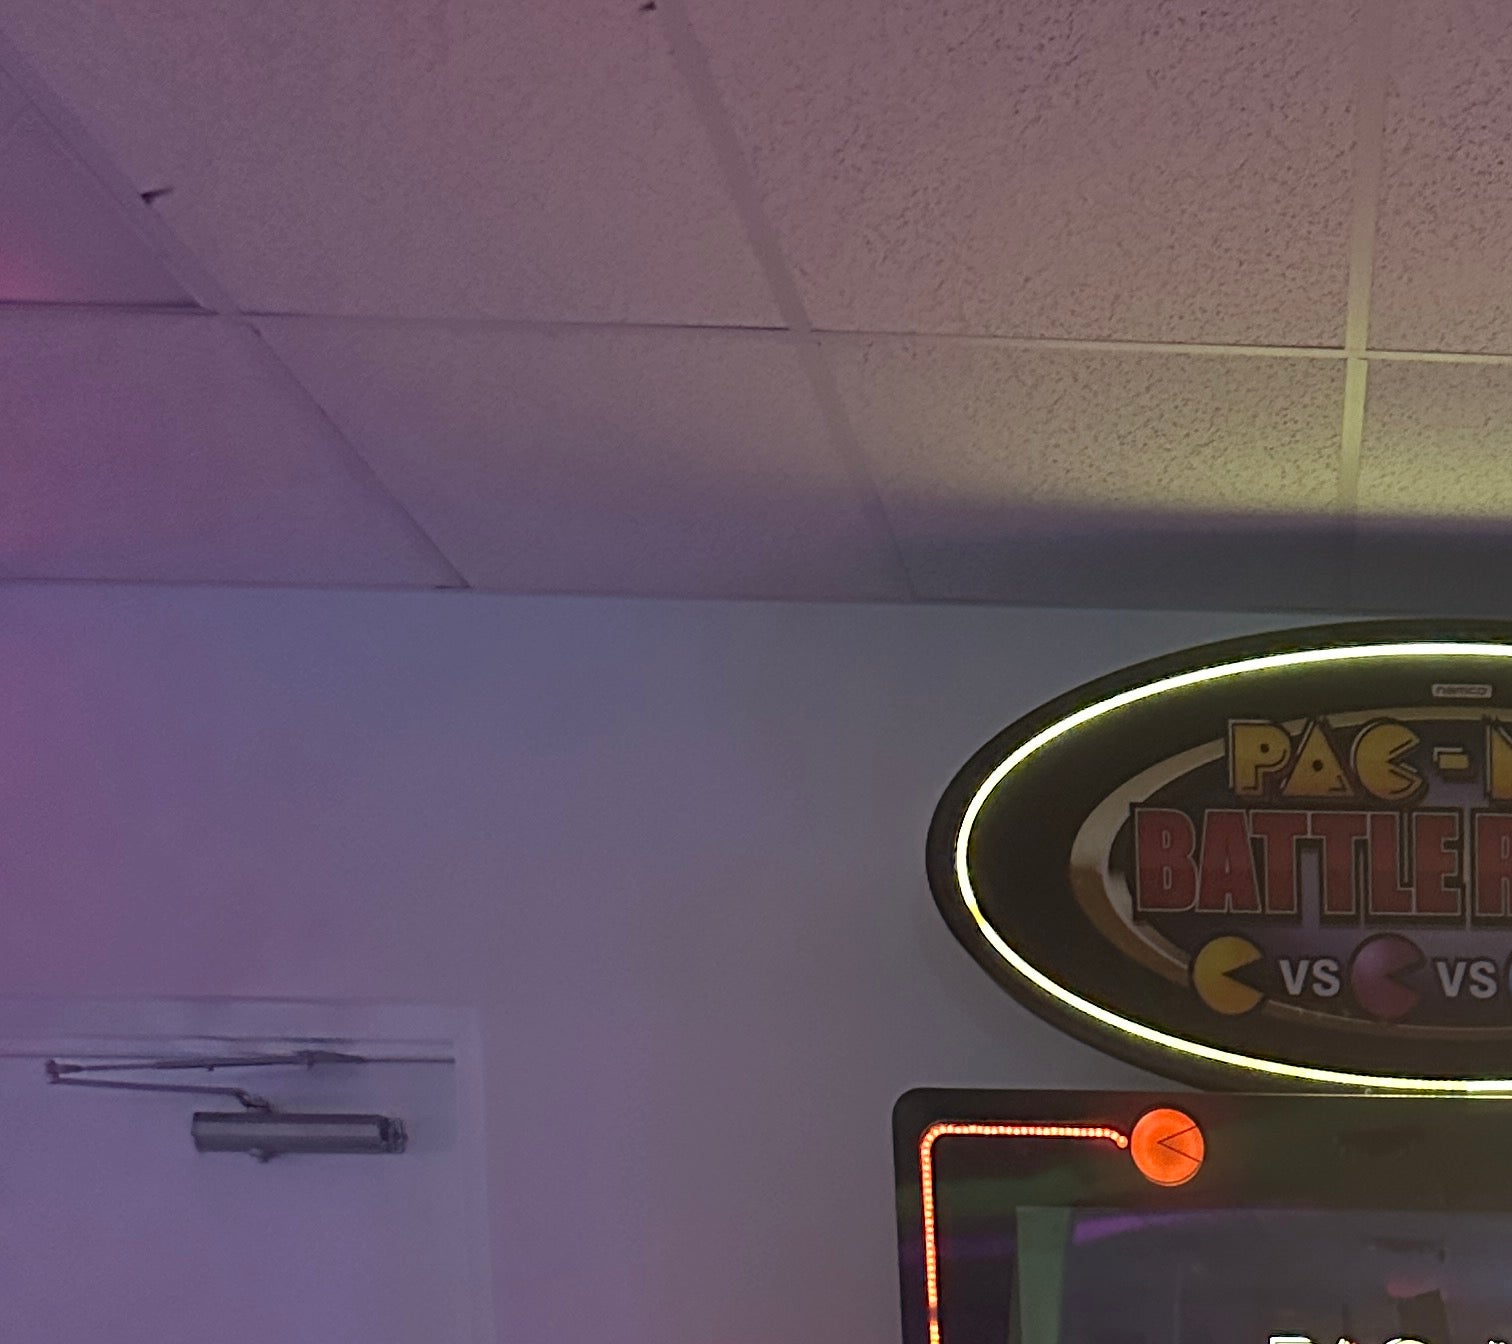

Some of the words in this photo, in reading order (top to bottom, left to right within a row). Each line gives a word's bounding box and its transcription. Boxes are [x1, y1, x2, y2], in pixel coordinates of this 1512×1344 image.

[1135, 808, 1463, 917] BATTLE
[1279, 958, 1340, 997] VS
[1437, 961, 1496, 999] VS
